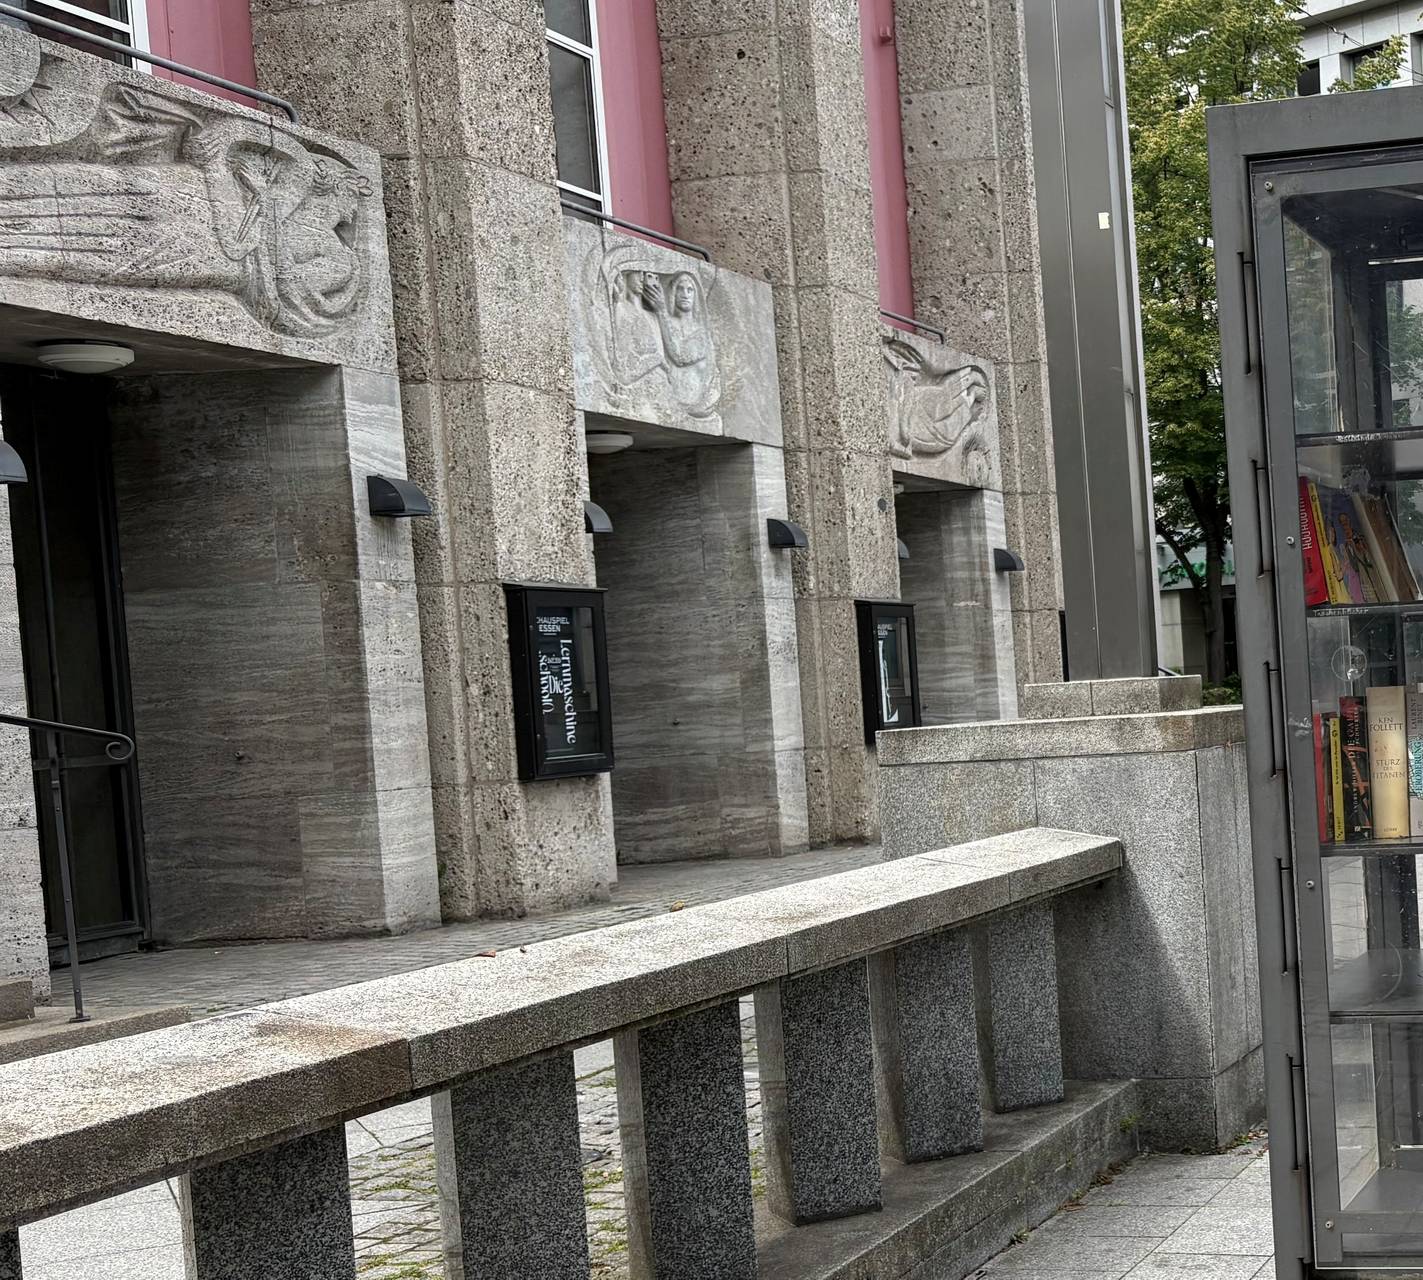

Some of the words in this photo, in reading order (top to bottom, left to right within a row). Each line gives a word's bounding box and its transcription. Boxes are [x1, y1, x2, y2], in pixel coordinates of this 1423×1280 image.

[538, 624, 561, 632] ESSEN
[548, 674, 564, 694] Die
[559, 639, 577, 744] Lernmaschine
[1370, 723, 1403, 732] FOLLETT
[1376, 758, 1401, 766] STURZ
